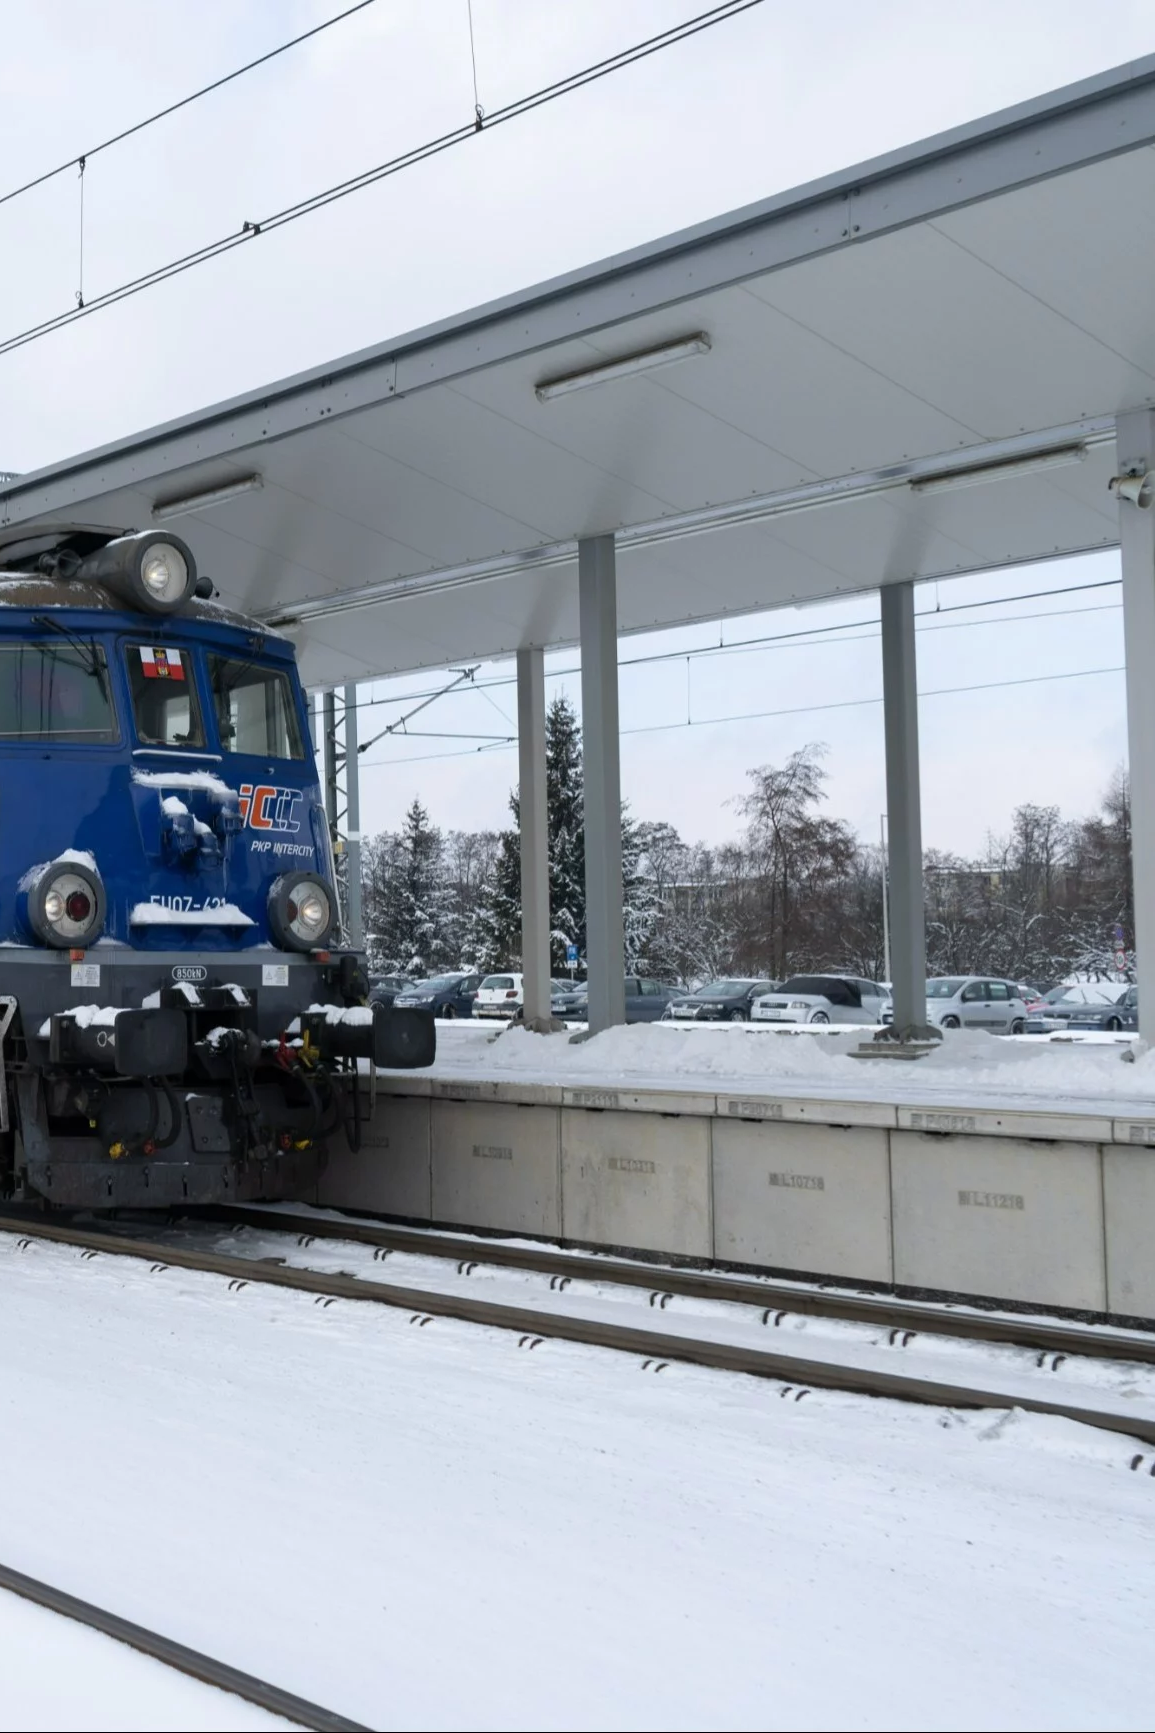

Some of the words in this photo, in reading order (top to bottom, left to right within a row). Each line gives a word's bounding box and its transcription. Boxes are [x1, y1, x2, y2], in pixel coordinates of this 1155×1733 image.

[250, 840, 272, 853] PKP
[273, 842, 315, 857] INTERCITY
[176, 968, 202, 978] 850kN
[973, 1191, 1025, 1211] L11218
